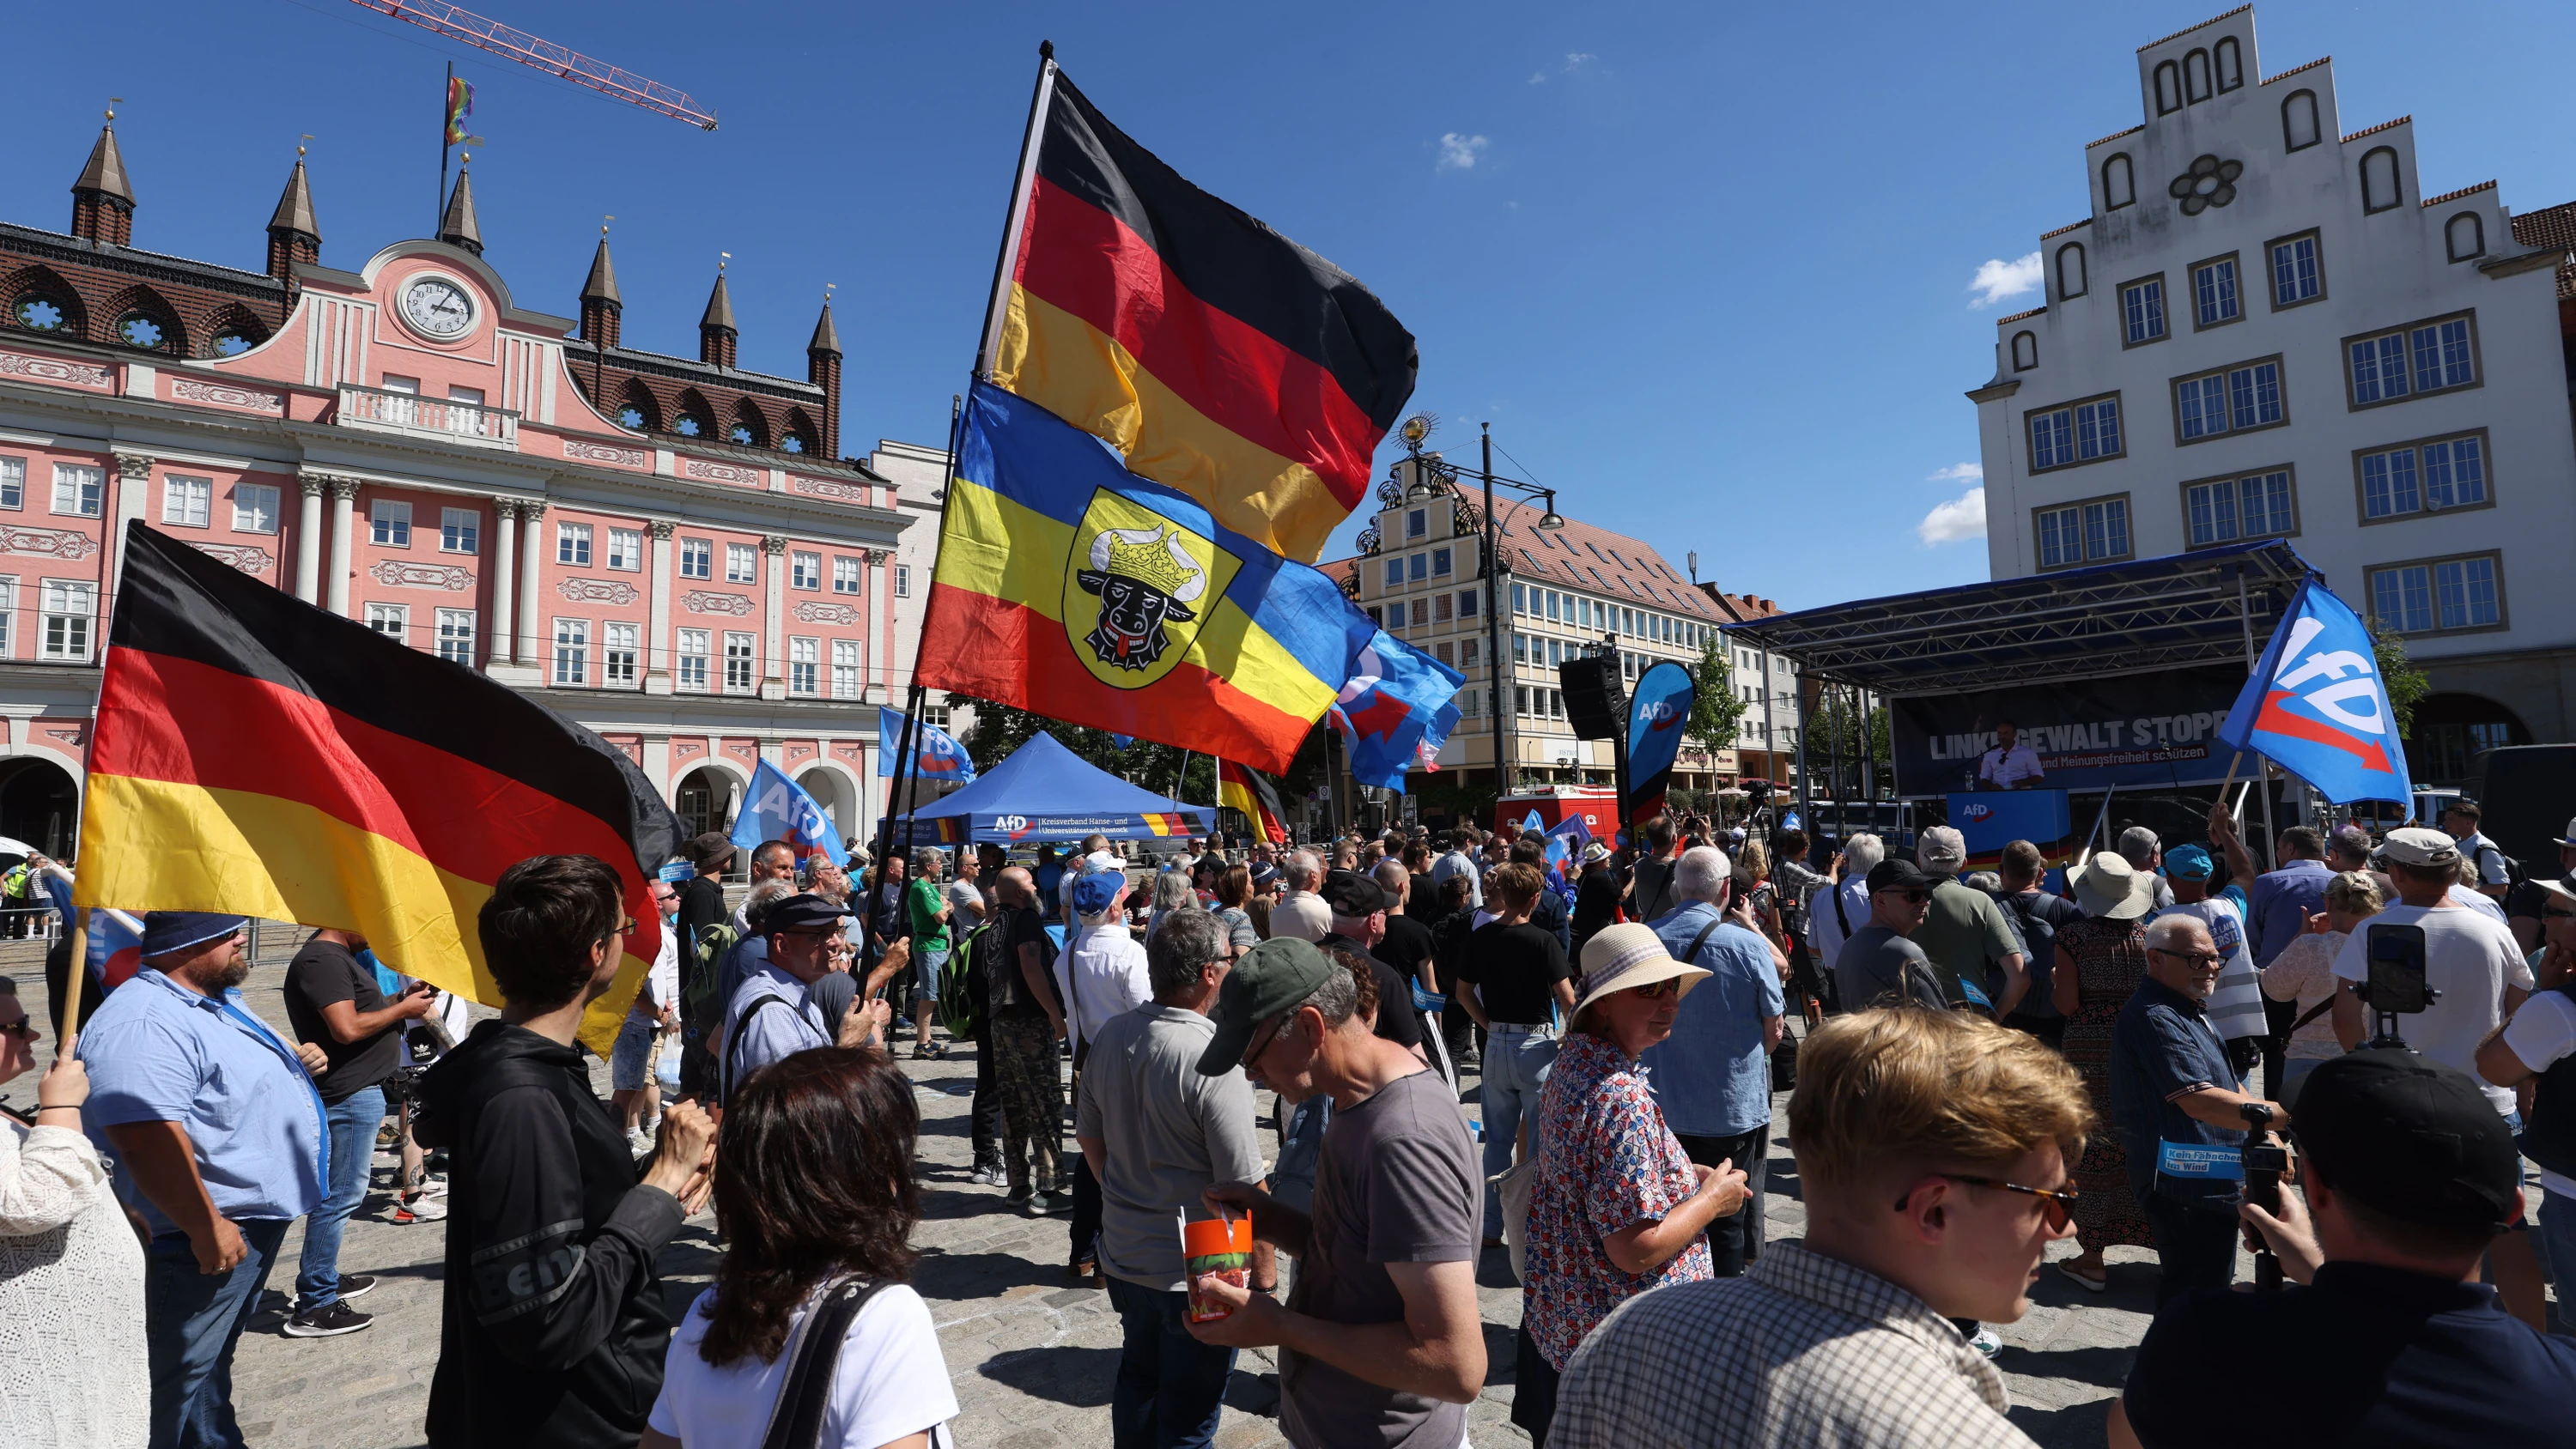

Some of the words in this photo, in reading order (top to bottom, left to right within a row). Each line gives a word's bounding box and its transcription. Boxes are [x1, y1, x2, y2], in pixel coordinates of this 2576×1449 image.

[423, 317, 429, 325] 7
[1638, 701, 1673, 720] AfD
[2016, 720, 2124, 754] GEWALT
[2040, 755, 2058, 769] und
[2061, 749, 2150, 768] Meinungsfreiheit
[750, 781, 826, 840] AfD
[1963, 804, 1988, 815] AfD
[993, 815, 1027, 832] AfD
[2219, 920, 2236, 933] LAND
[2168, 1149, 2191, 1160] Kein
[2193, 1150, 2242, 1162] Fähnchen
[2166, 1161, 2180, 1170] im
[2183, 1161, 2208, 1171] Wind
